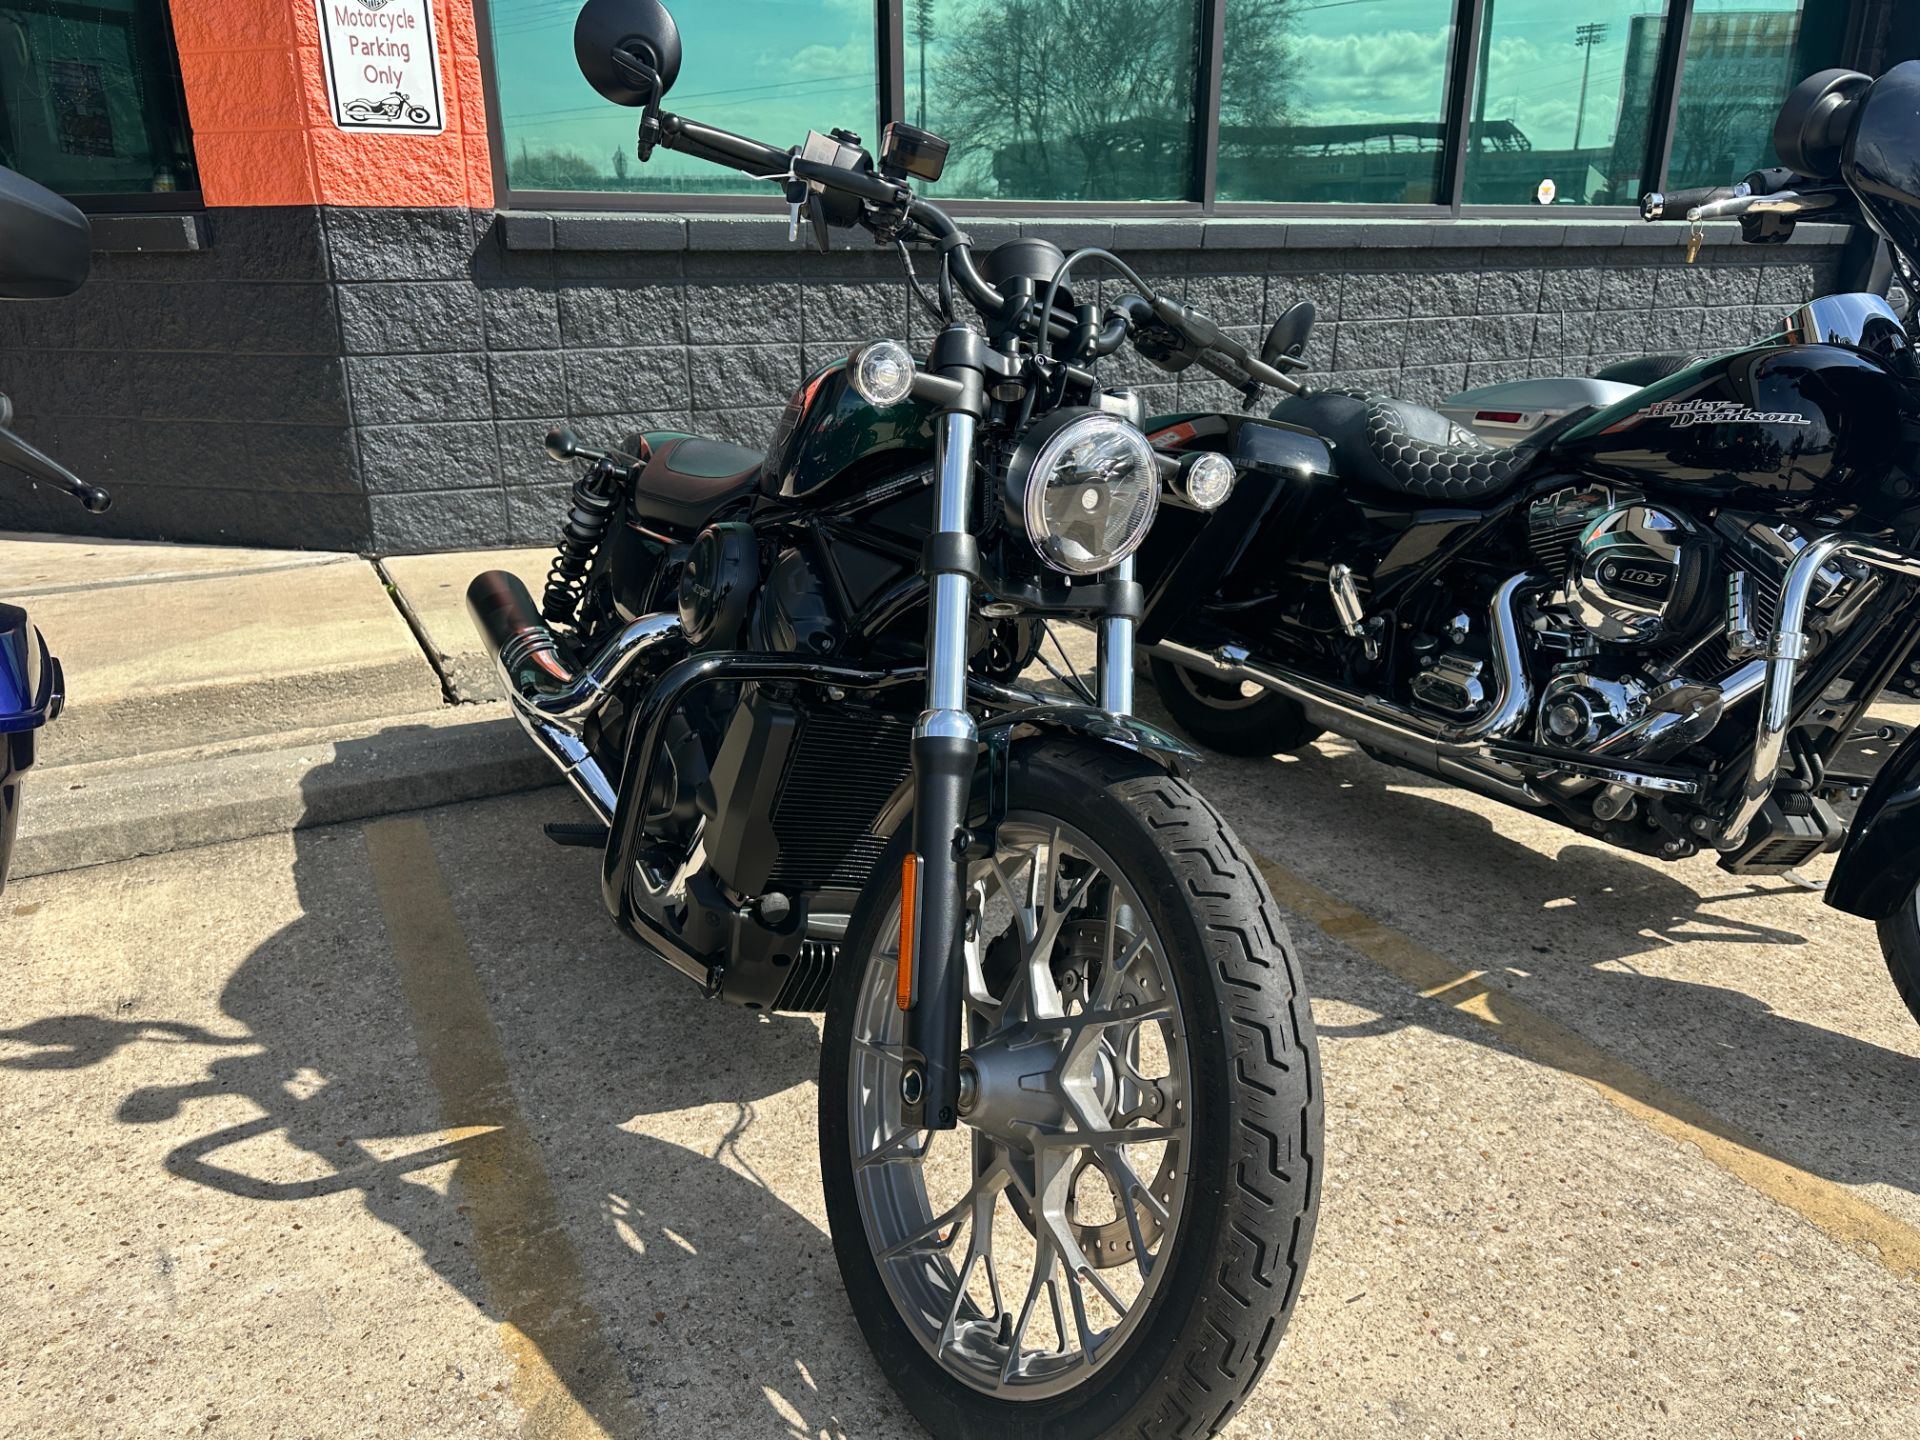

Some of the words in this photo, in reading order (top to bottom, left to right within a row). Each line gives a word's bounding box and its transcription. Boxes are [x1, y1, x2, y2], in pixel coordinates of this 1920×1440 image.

[334, 5, 415, 33] Motorcycle
[349, 35, 411, 63] Parking
[363, 64, 403, 89] Only
[1670, 408, 1811, 428] Davidson
[1620, 568, 1667, 587] 103
